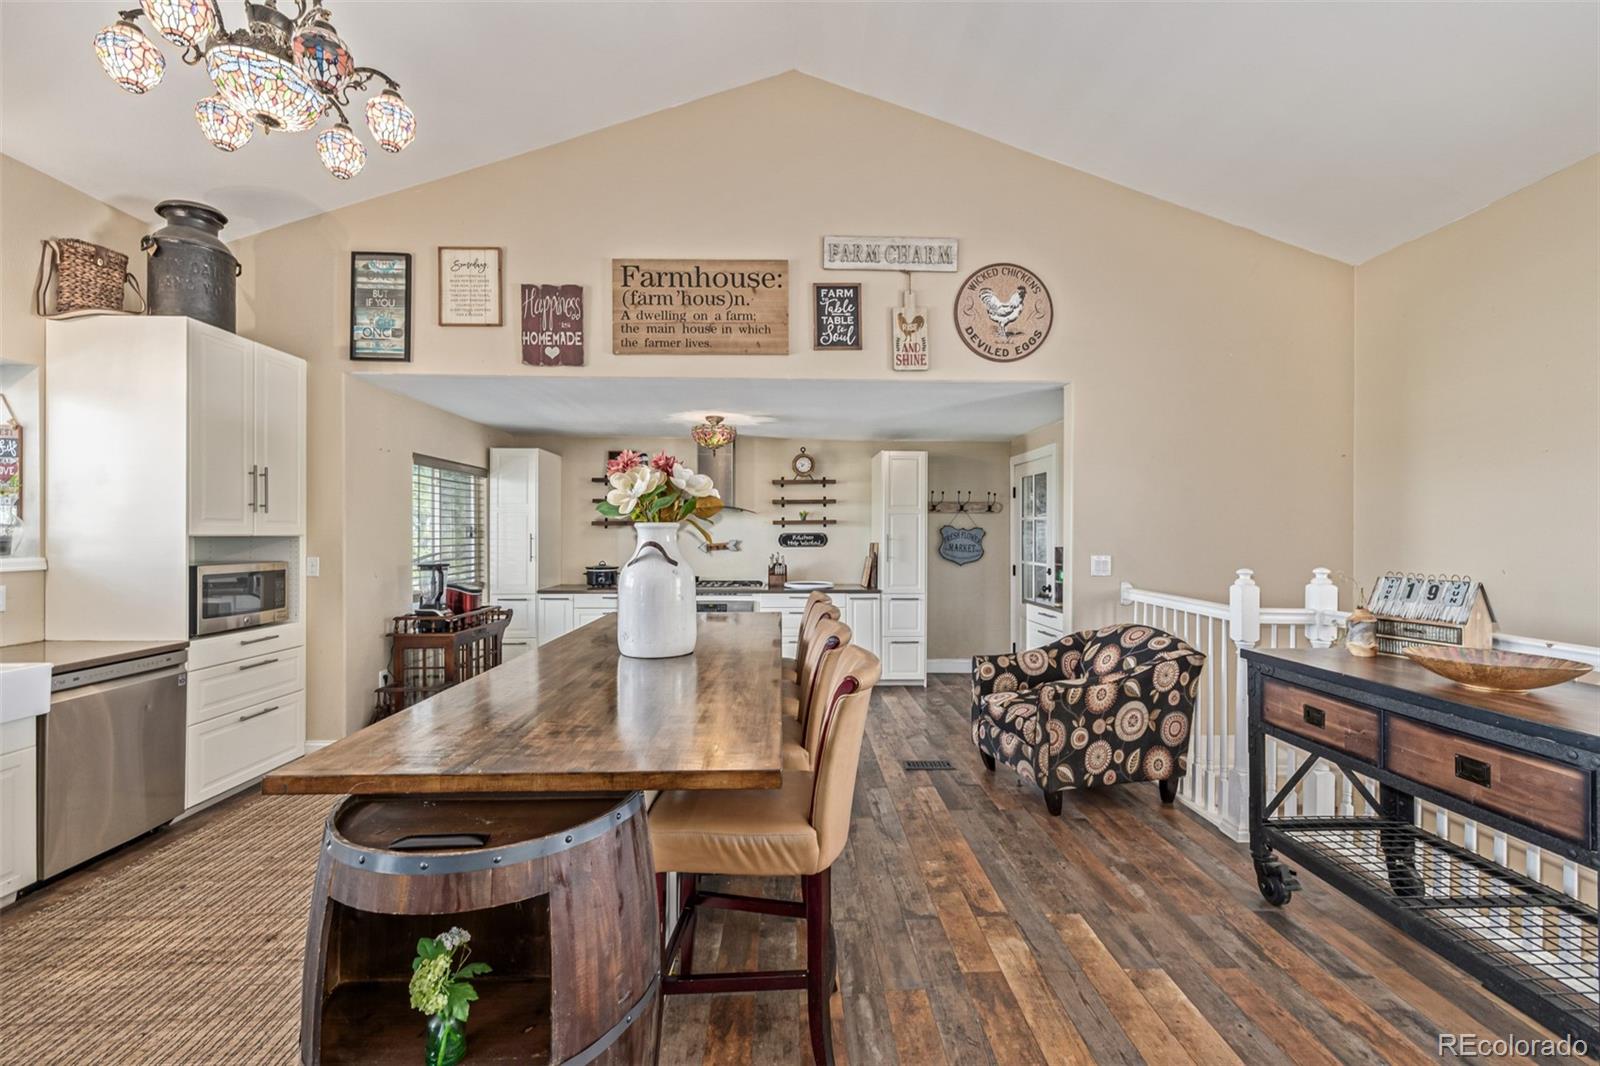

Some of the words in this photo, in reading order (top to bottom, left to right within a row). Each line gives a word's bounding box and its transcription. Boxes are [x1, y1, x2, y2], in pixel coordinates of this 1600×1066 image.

[828, 243, 881, 264] FARM
[884, 244, 953, 265] CHARM
[620, 265, 782, 288] Farmhouse:
[967, 267, 999, 291] WICKED
[1001, 267, 1042, 295] CHICKENS
[820, 289, 854, 298] FARM
[366, 298, 373, 307] IF
[375, 298, 396, 307] YOU
[523, 287, 581, 331] Happiness
[819, 298, 855, 315] Table
[620, 311, 630, 321] A
[636, 310, 686, 323] dwelling
[693, 313, 708, 321] on
[714, 313, 721, 321] a
[620, 323, 639, 334] the
[646, 324, 675, 334] main
[682, 323, 717, 334] house
[722, 323, 732, 334] in
[738, 323, 771, 335] which
[820, 324, 856, 345] Soul
[522, 331, 583, 346] HOMEMADE
[620, 337, 638, 348] the
[644, 337, 681, 348] farmer
[685, 337, 713, 348] lives.
[965, 326, 1009, 357] DEVILED
[1014, 329, 1042, 355] EGGS
[902, 343, 920, 353] AND
[895, 354, 927, 366] SHINE
[949, 544, 976, 552] MARKET
